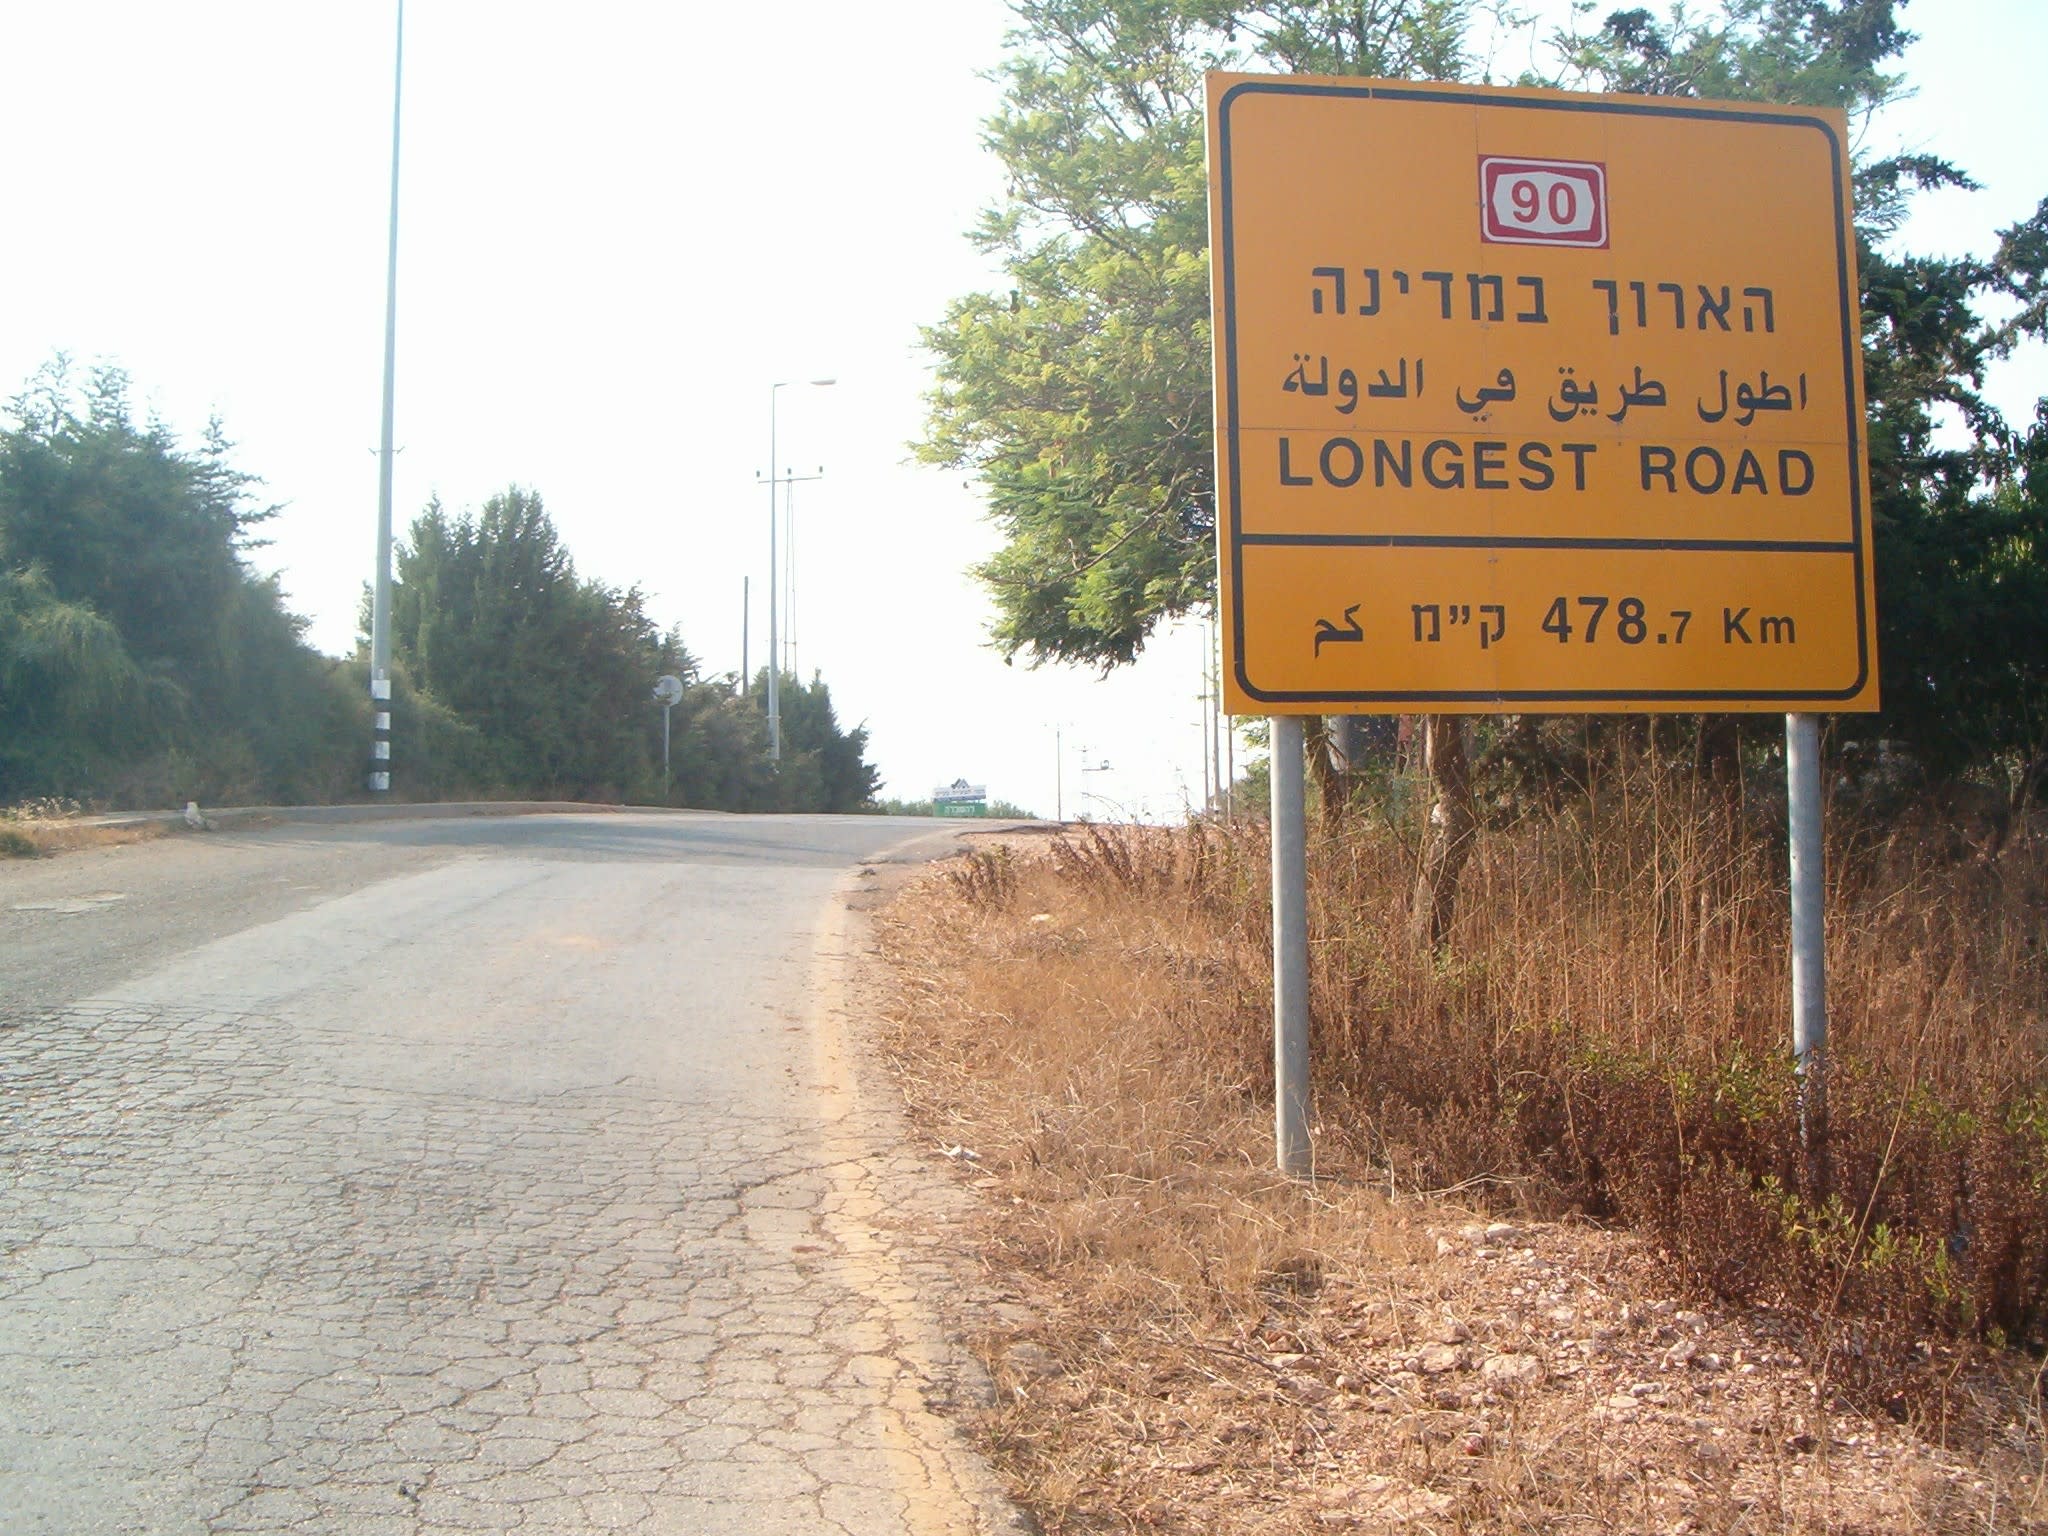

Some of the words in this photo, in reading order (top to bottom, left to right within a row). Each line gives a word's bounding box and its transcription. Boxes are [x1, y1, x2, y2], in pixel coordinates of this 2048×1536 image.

[1511, 180, 1577, 225] 90
[1312, 266, 1548, 323] במדינה
[1592, 280, 1775, 335] הארוך
[1282, 350, 1424, 414] الدولة
[1456, 366, 1516, 422] في
[1548, 366, 1667, 424] طريق
[1697, 369, 1807, 427] اطول
[1280, 437, 1597, 491] LONGEST
[1640, 445, 1815, 496] ROAD
[1314, 604, 1363, 658] كم
[1542, 596, 1692, 645] 478.7
[1724, 607, 1796, 645] Km
